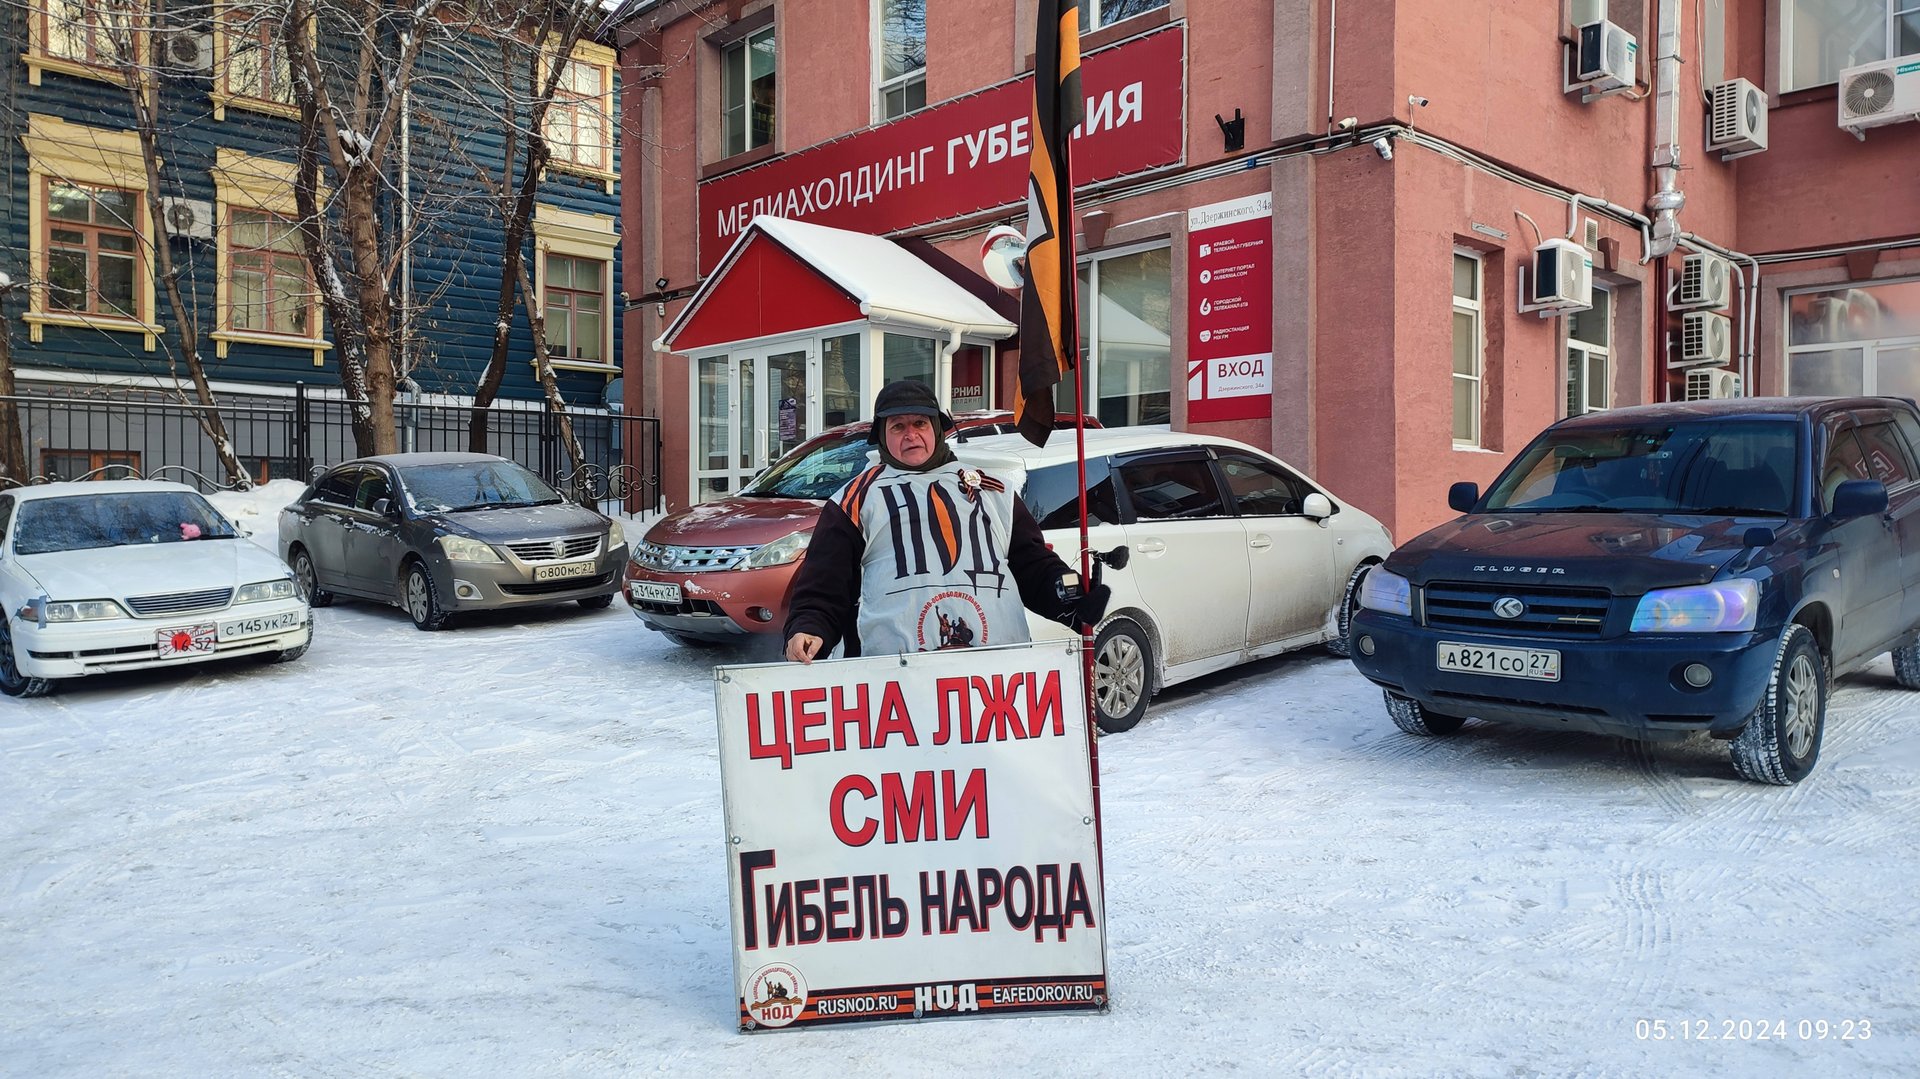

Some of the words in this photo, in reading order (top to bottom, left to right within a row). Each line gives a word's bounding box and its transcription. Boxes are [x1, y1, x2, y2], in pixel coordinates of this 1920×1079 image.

[718, 145, 934, 238] МЕДИАХОЛДИНГ
[947, 81, 1143, 175] ГУБЕИЯ
[1218, 360, 1264, 377] ВХОД
[582, 562, 592, 572] 27
[1473, 565, 1565, 575] KLUGER
[666, 587, 675, 597] 27
[282, 613, 294, 624] 27
[1530, 654, 1550, 669] 27
[745, 680, 919, 770] ЦЕНА
[933, 669, 1066, 746] ЛЖИ
[829, 767, 990, 847] СМИ
[918, 862, 1096, 943] НАРОДА
[914, 983, 979, 1012] НОД
[992, 985, 1093, 1004] EAFEDOROV.RU
[761, 1005, 794, 1020] НОД
[817, 995, 898, 1015] RUSNOD.RU
